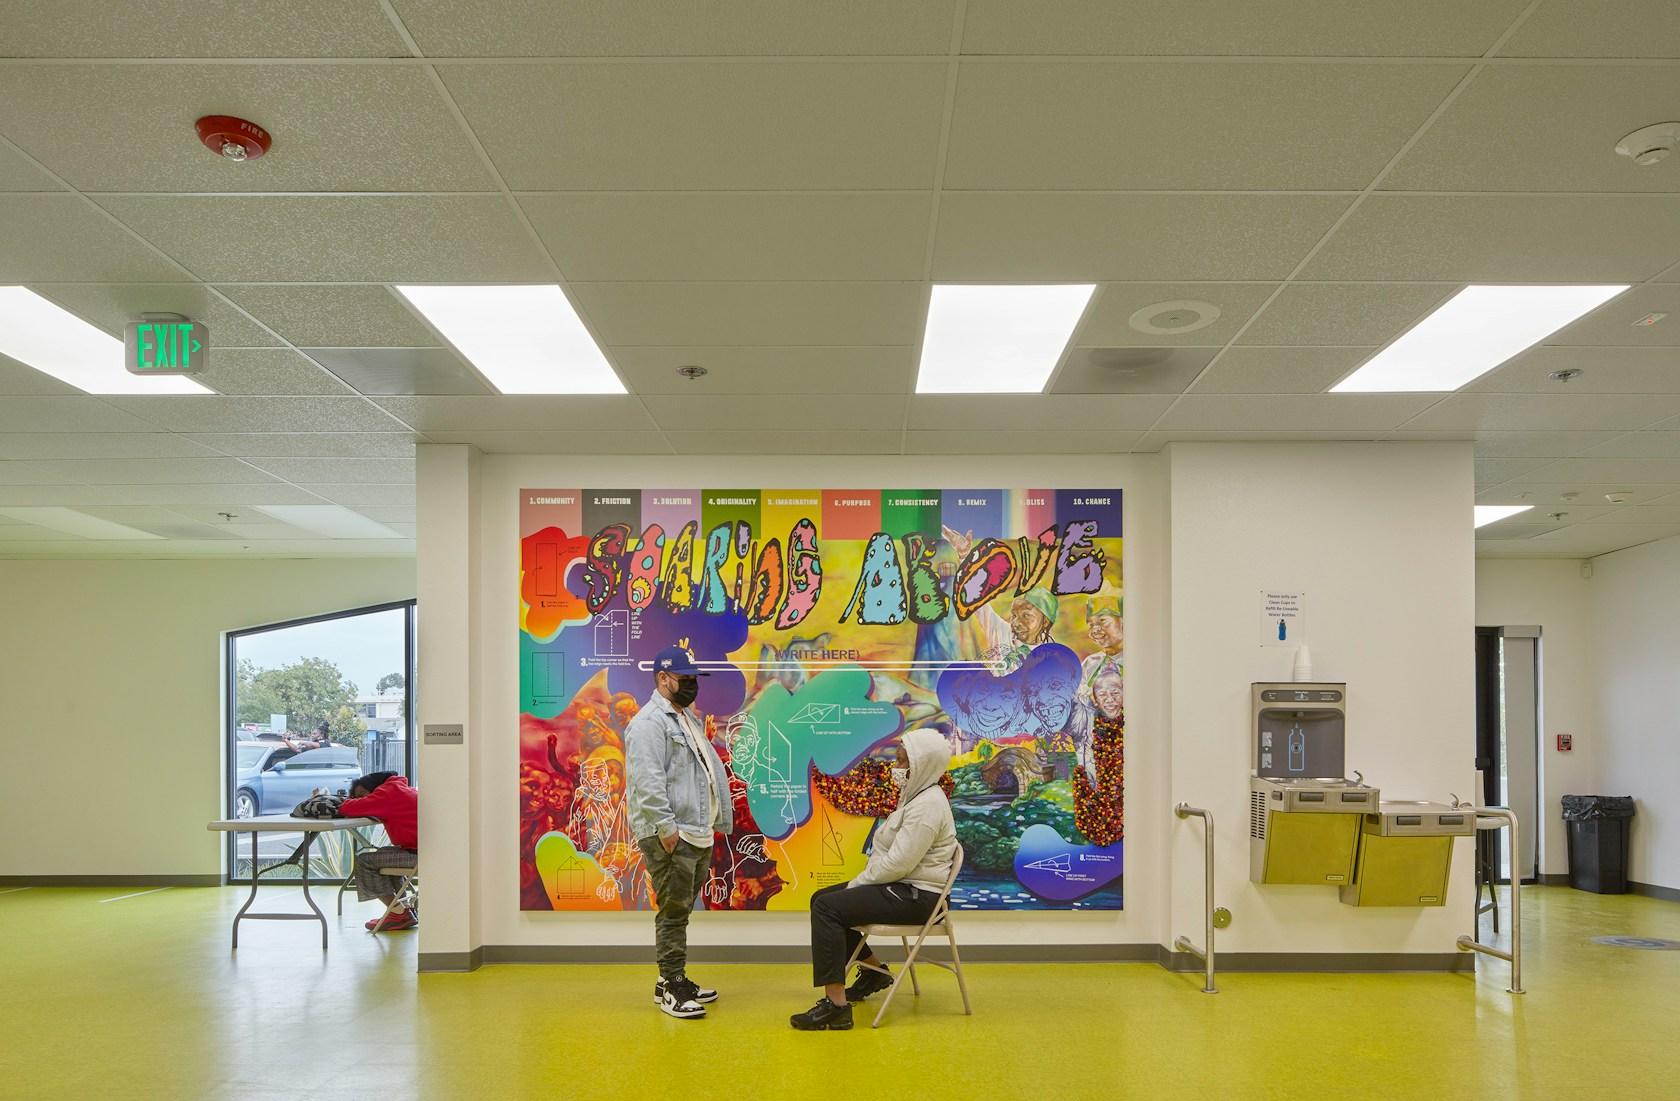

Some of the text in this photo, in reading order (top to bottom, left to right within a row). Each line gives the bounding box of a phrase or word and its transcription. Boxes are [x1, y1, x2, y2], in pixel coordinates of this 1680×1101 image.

[241, 123, 264, 138] FIRE
[137, 323, 193, 368] EXIT
[529, 497, 575, 505] 1. COMMUNITY
